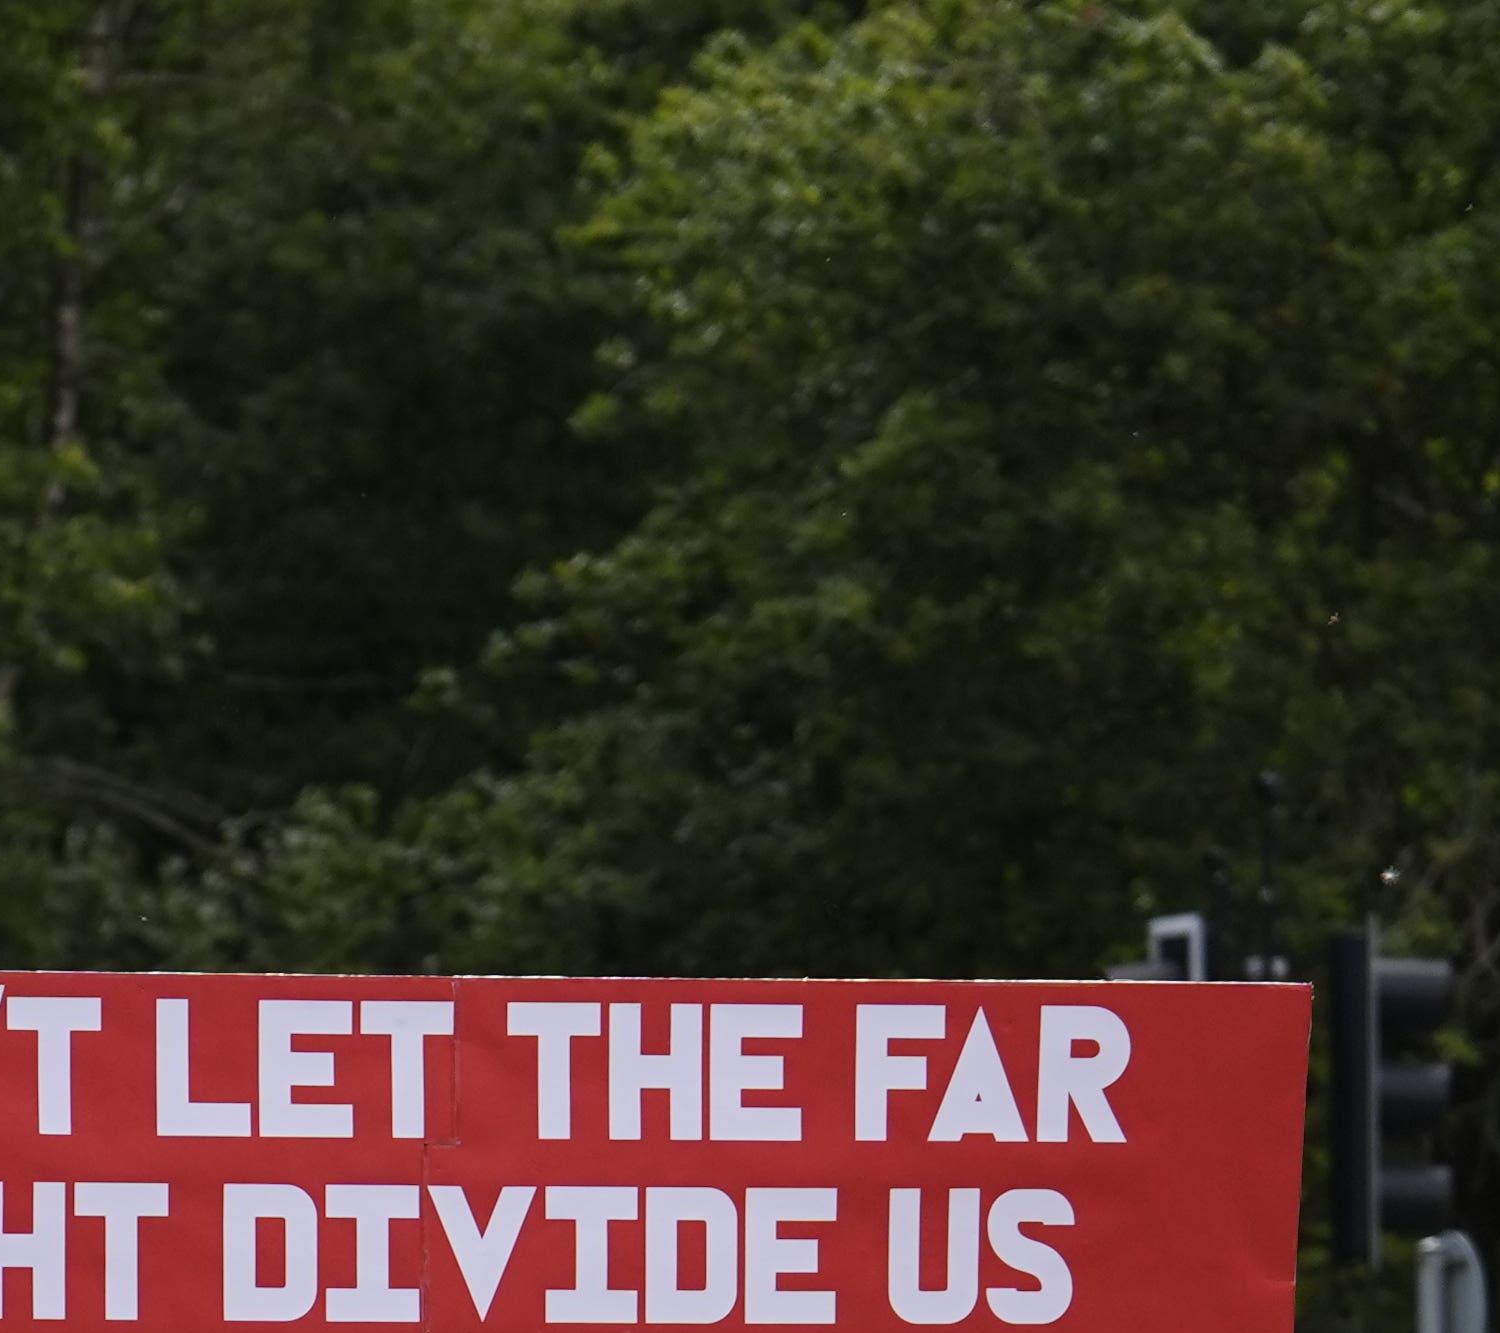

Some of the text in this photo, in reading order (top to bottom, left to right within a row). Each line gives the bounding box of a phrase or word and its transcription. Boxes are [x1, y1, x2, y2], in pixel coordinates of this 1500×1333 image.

[155, 998, 454, 1139] LET
[506, 1002, 803, 1141] THE
[855, 1004, 1131, 1143] FAR
[224, 1183, 838, 1325] DIVIDE
[887, 1187, 1075, 1326] US
